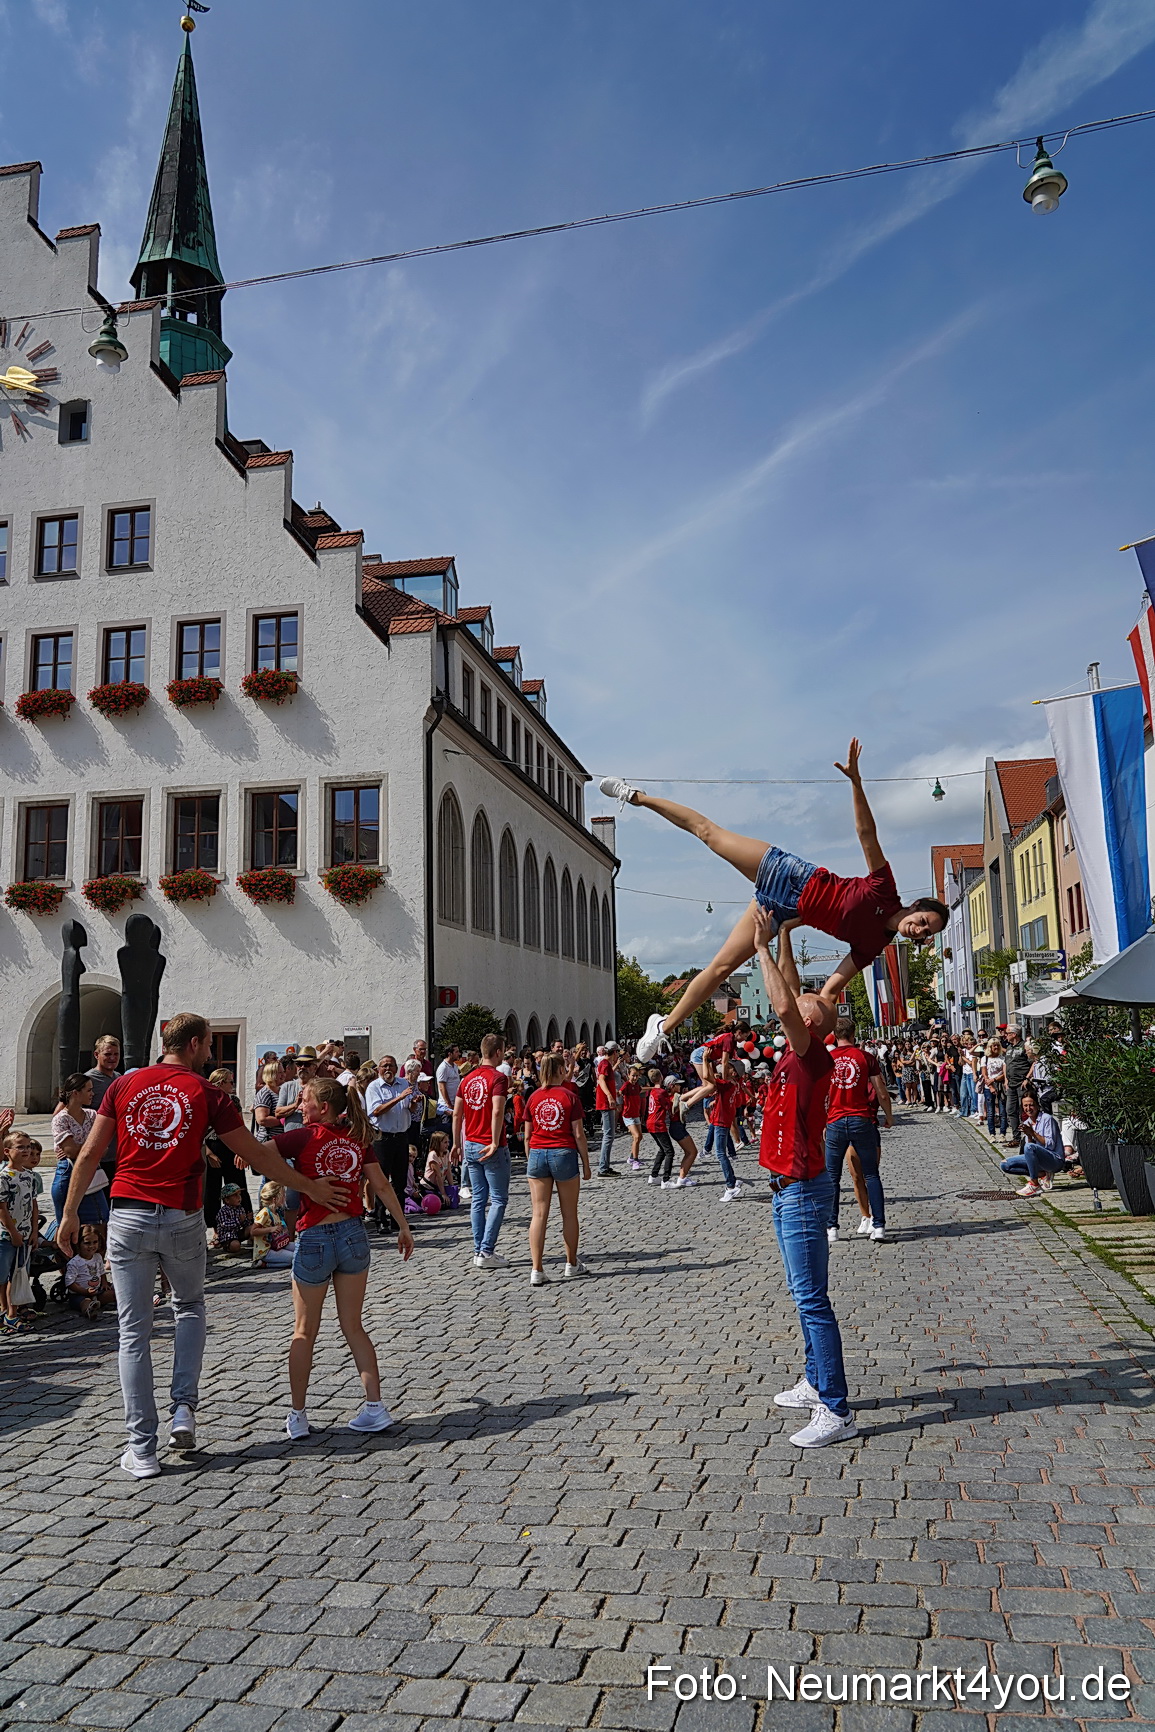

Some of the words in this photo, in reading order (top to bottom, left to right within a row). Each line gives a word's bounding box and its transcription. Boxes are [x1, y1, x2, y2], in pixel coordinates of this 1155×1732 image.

[1024, 951, 1055, 959] Klostergasse
[163, 1084, 178, 1094] the
[125, 1114, 137, 1136] DJK
[137, 1138, 153, 1149] SV
[154, 1137, 179, 1150] Berg
